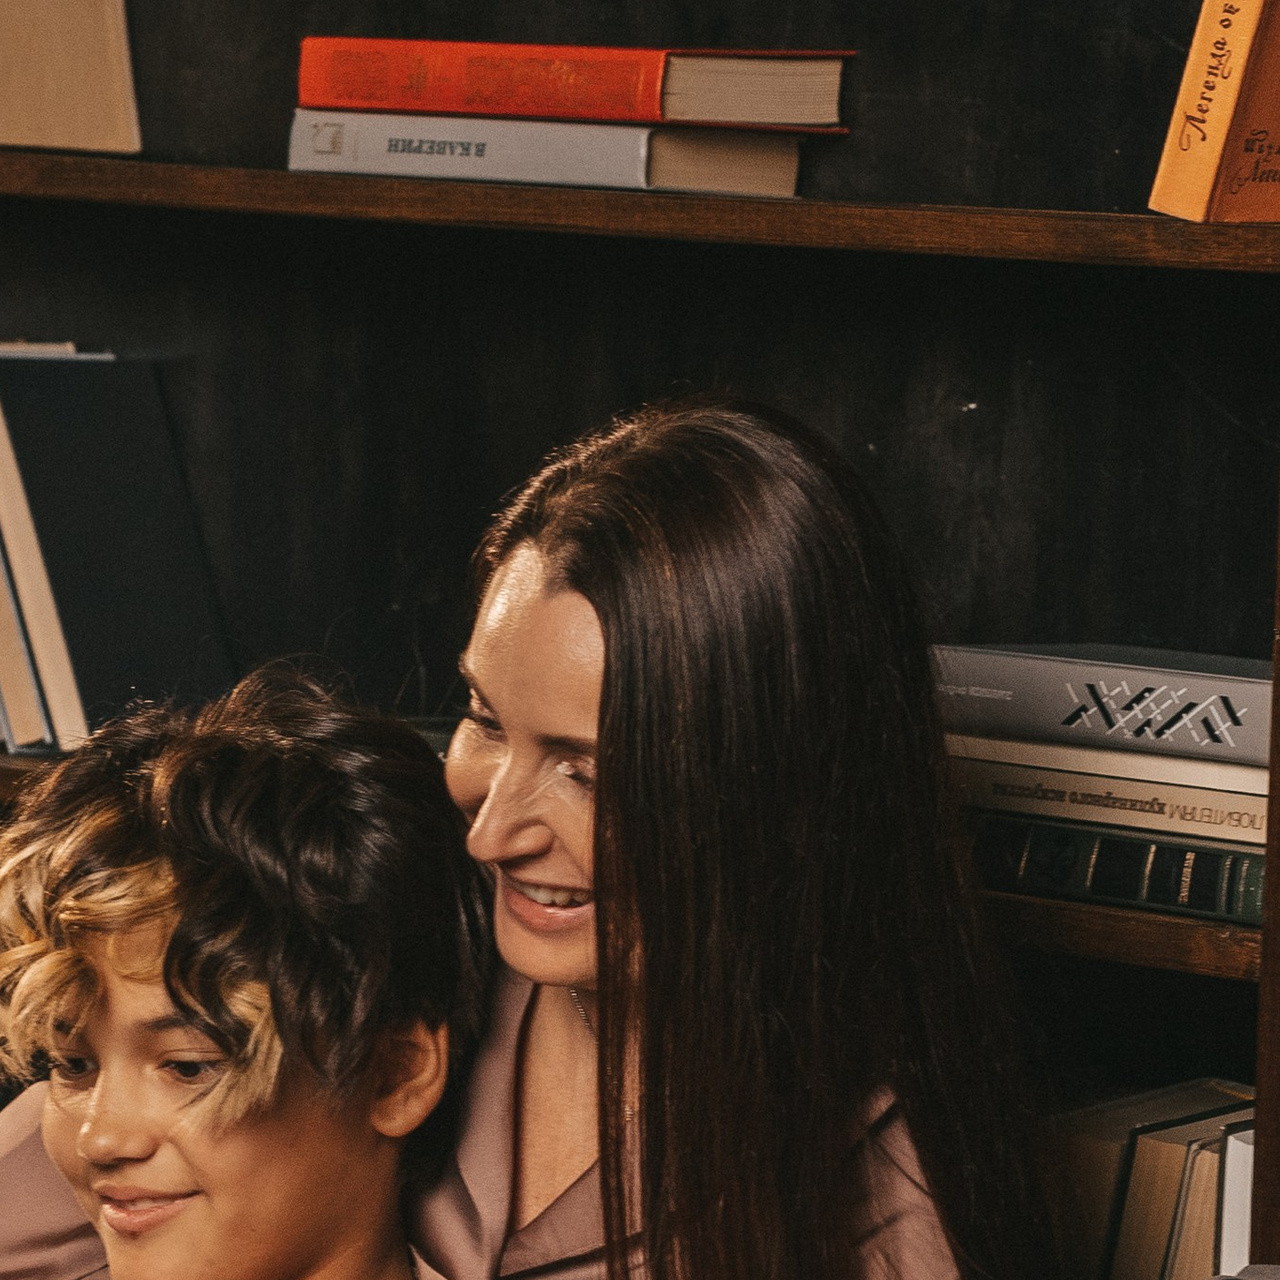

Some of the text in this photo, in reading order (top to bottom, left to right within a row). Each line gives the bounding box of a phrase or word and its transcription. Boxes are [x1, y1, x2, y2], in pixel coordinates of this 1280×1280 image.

[1178, 37, 1231, 151] Легенда
[387, 138, 471, 157] КАВЕРИН
[1169, 802, 1267, 831] ЛЮБИТЕЛЯМ
